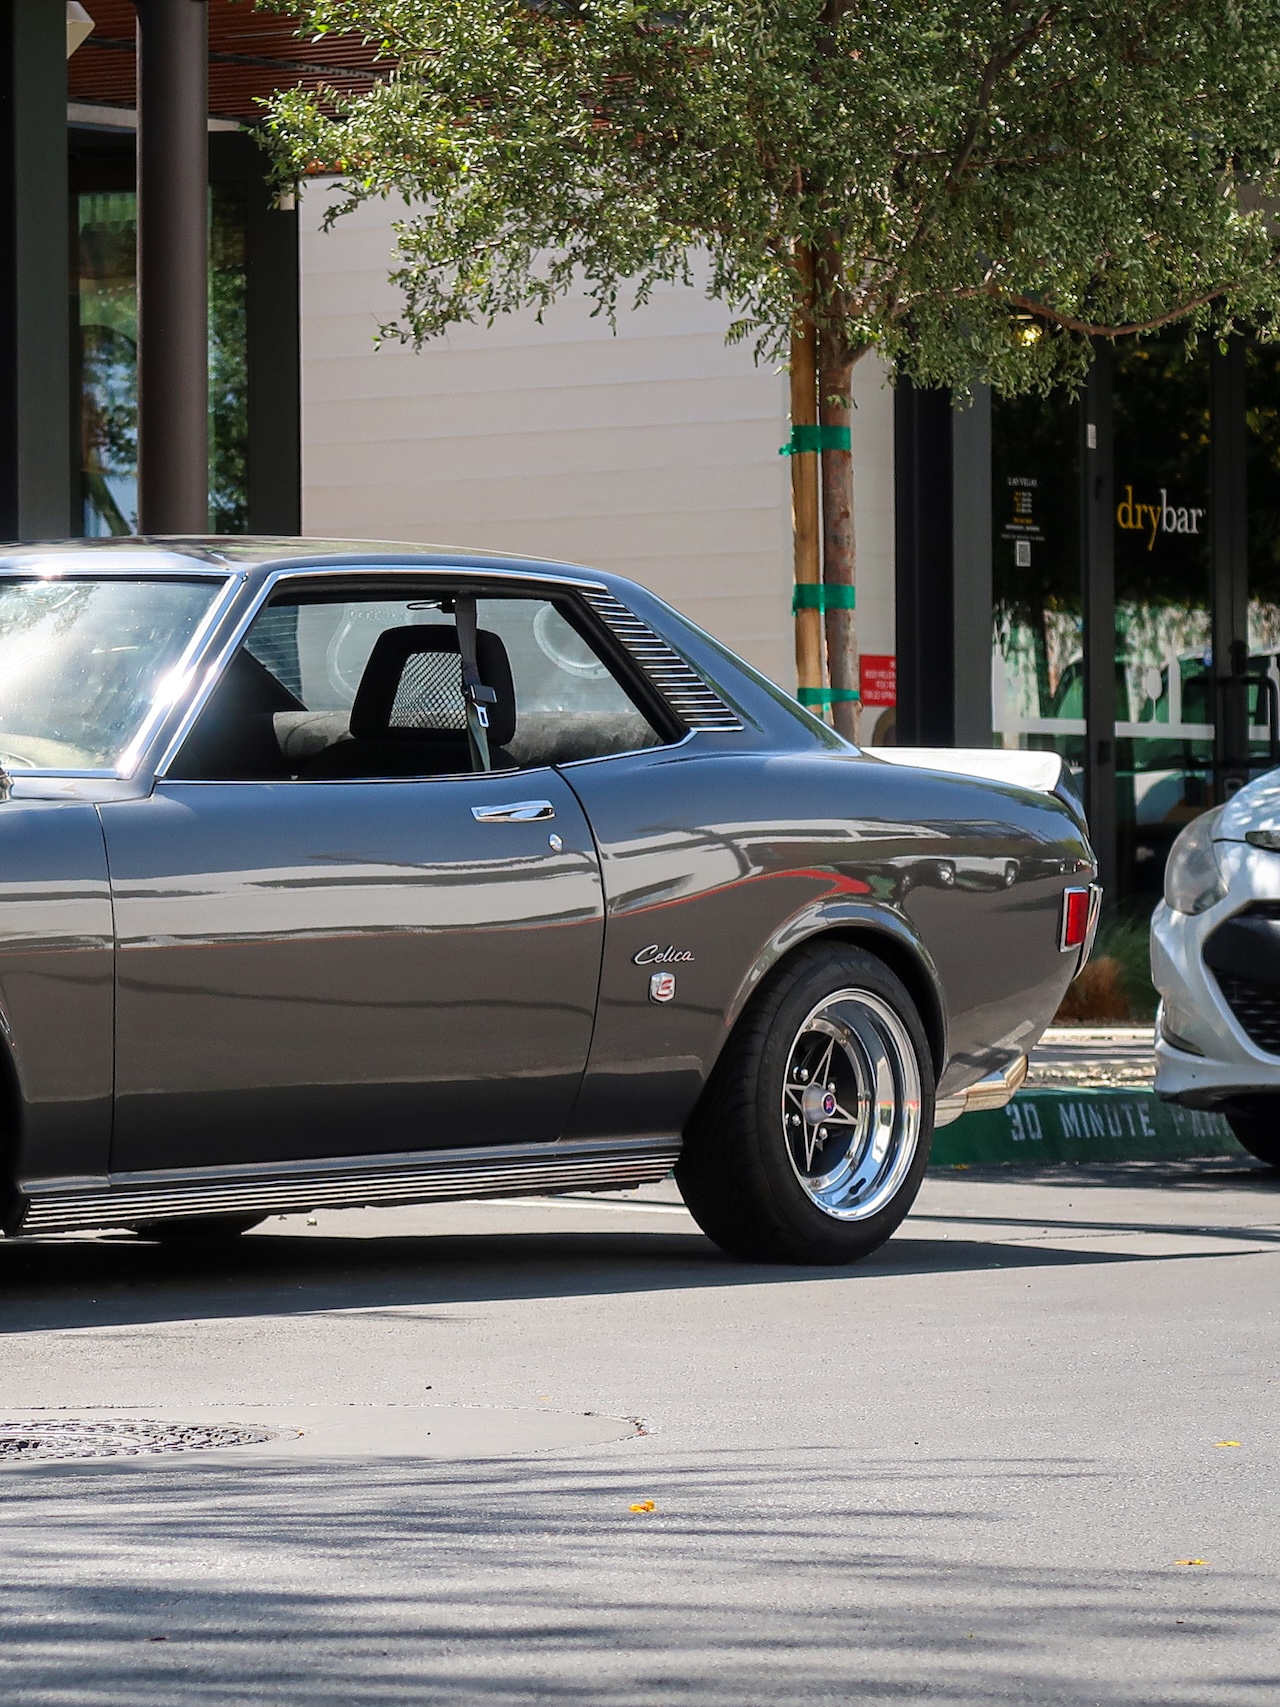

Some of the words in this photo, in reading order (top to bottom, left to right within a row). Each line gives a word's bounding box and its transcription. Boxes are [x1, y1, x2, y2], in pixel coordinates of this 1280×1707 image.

[1117, 484, 1200, 551] drybar
[634, 944, 695, 965] Celica
[1005, 1102, 1043, 1142] 30
[1058, 1102, 1156, 1140] MINUTE
